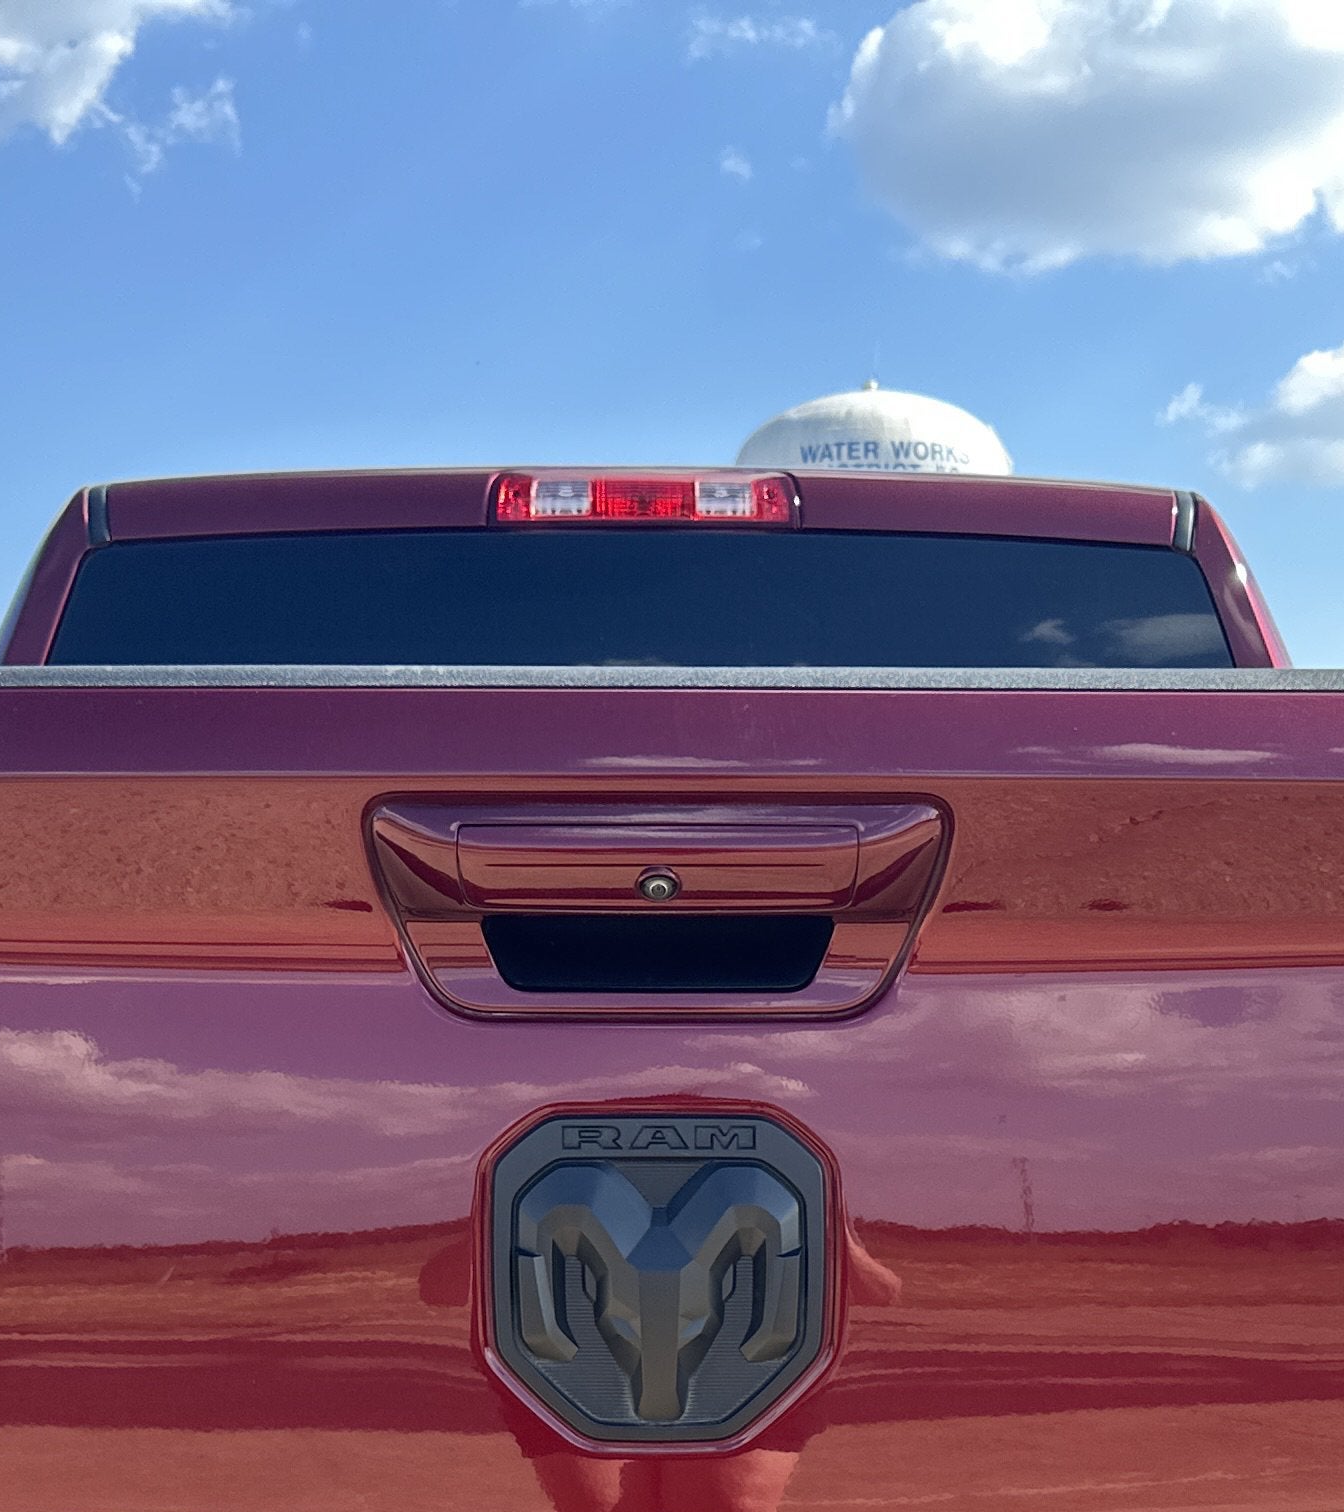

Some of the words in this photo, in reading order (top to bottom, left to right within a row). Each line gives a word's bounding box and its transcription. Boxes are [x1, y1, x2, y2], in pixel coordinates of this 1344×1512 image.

[799, 441, 880, 464] WATER
[891, 440, 970, 465] WORKS
[561, 1124, 757, 1151] RAM
